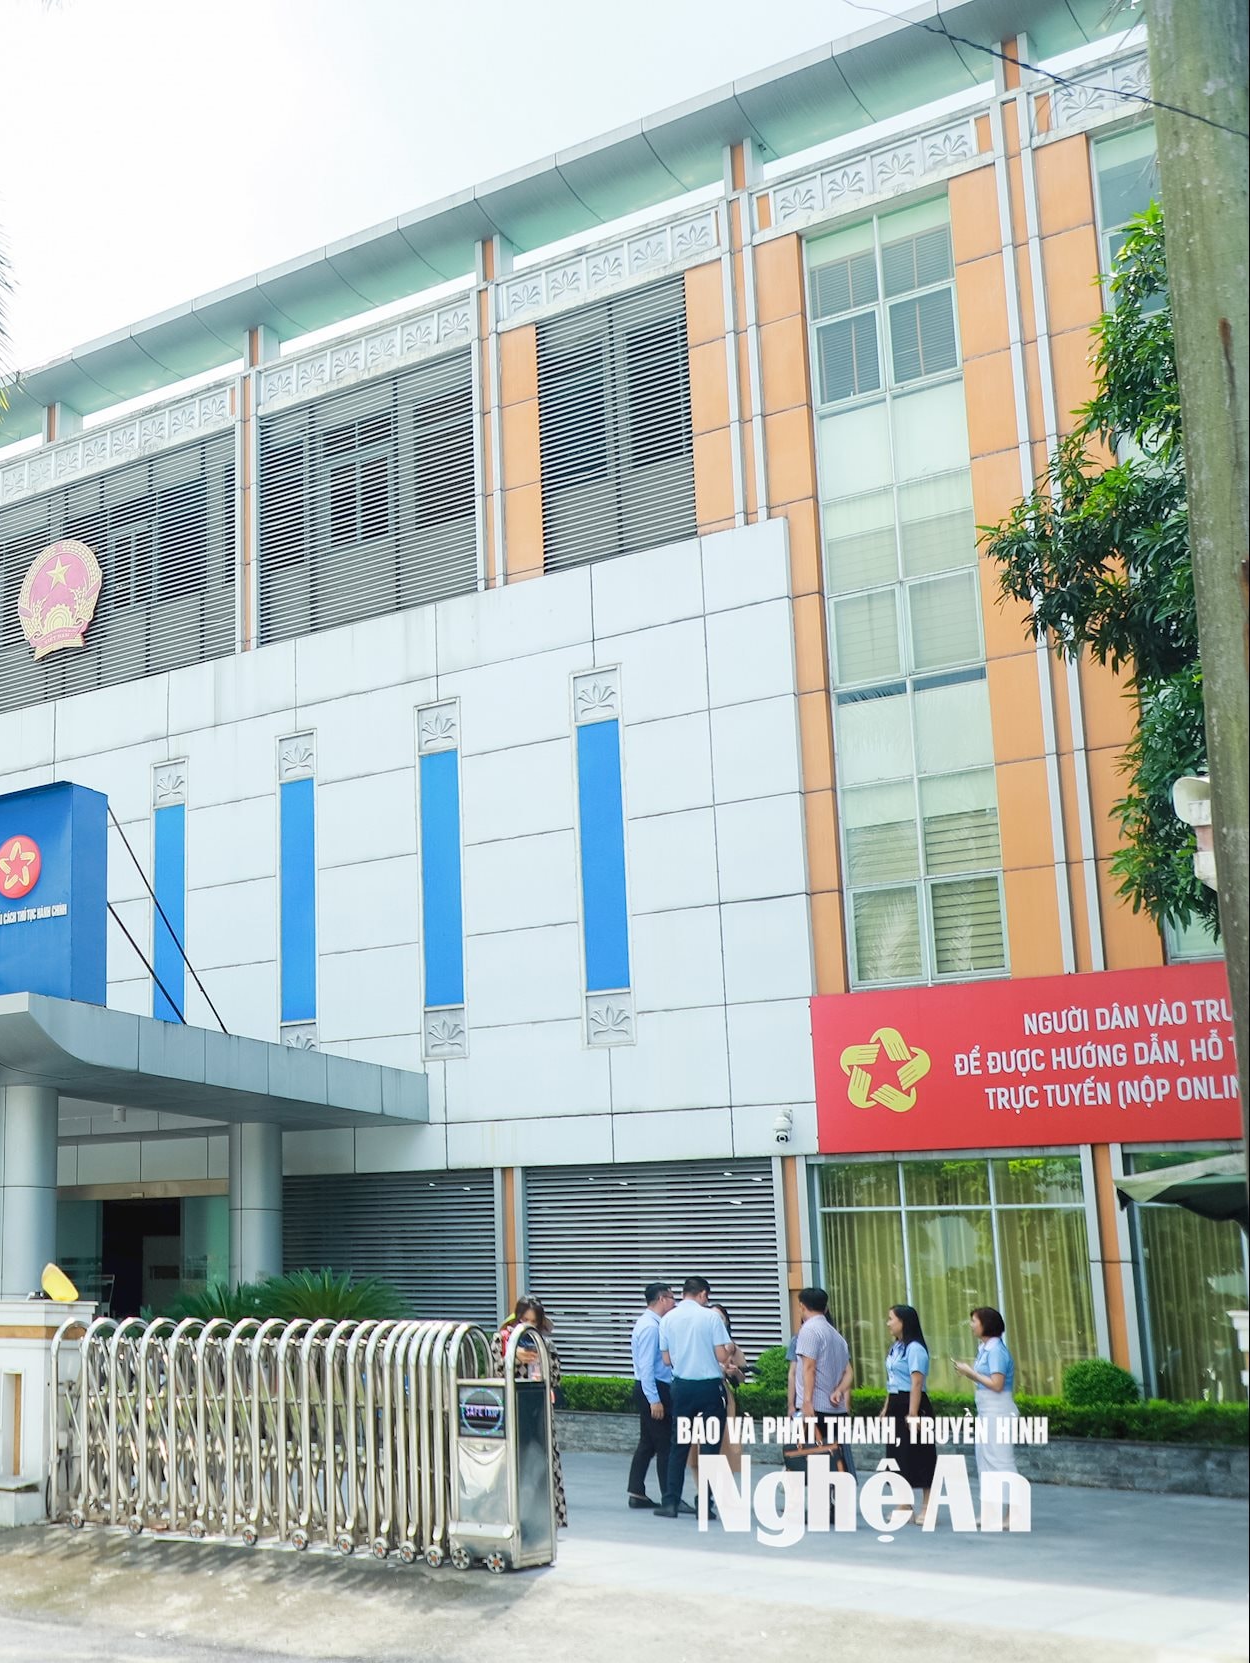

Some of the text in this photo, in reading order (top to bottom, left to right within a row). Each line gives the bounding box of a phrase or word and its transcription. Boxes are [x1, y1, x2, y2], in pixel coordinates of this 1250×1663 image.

[1024, 998, 1233, 1035] NGƯỜI DÂN VÀO TRU
[954, 1044, 982, 1076] ĐỂ
[987, 1048, 1046, 1078] ĐƯỢC
[1051, 1041, 1128, 1070] HƯỚNG
[1134, 1033, 1185, 1067] DẪN,
[1190, 1029, 1224, 1062] HỖ
[984, 1074, 1239, 1114] TRỰC TUYẾN (NỘP ONLIN
[466, 1407, 483, 1417] SAFE
